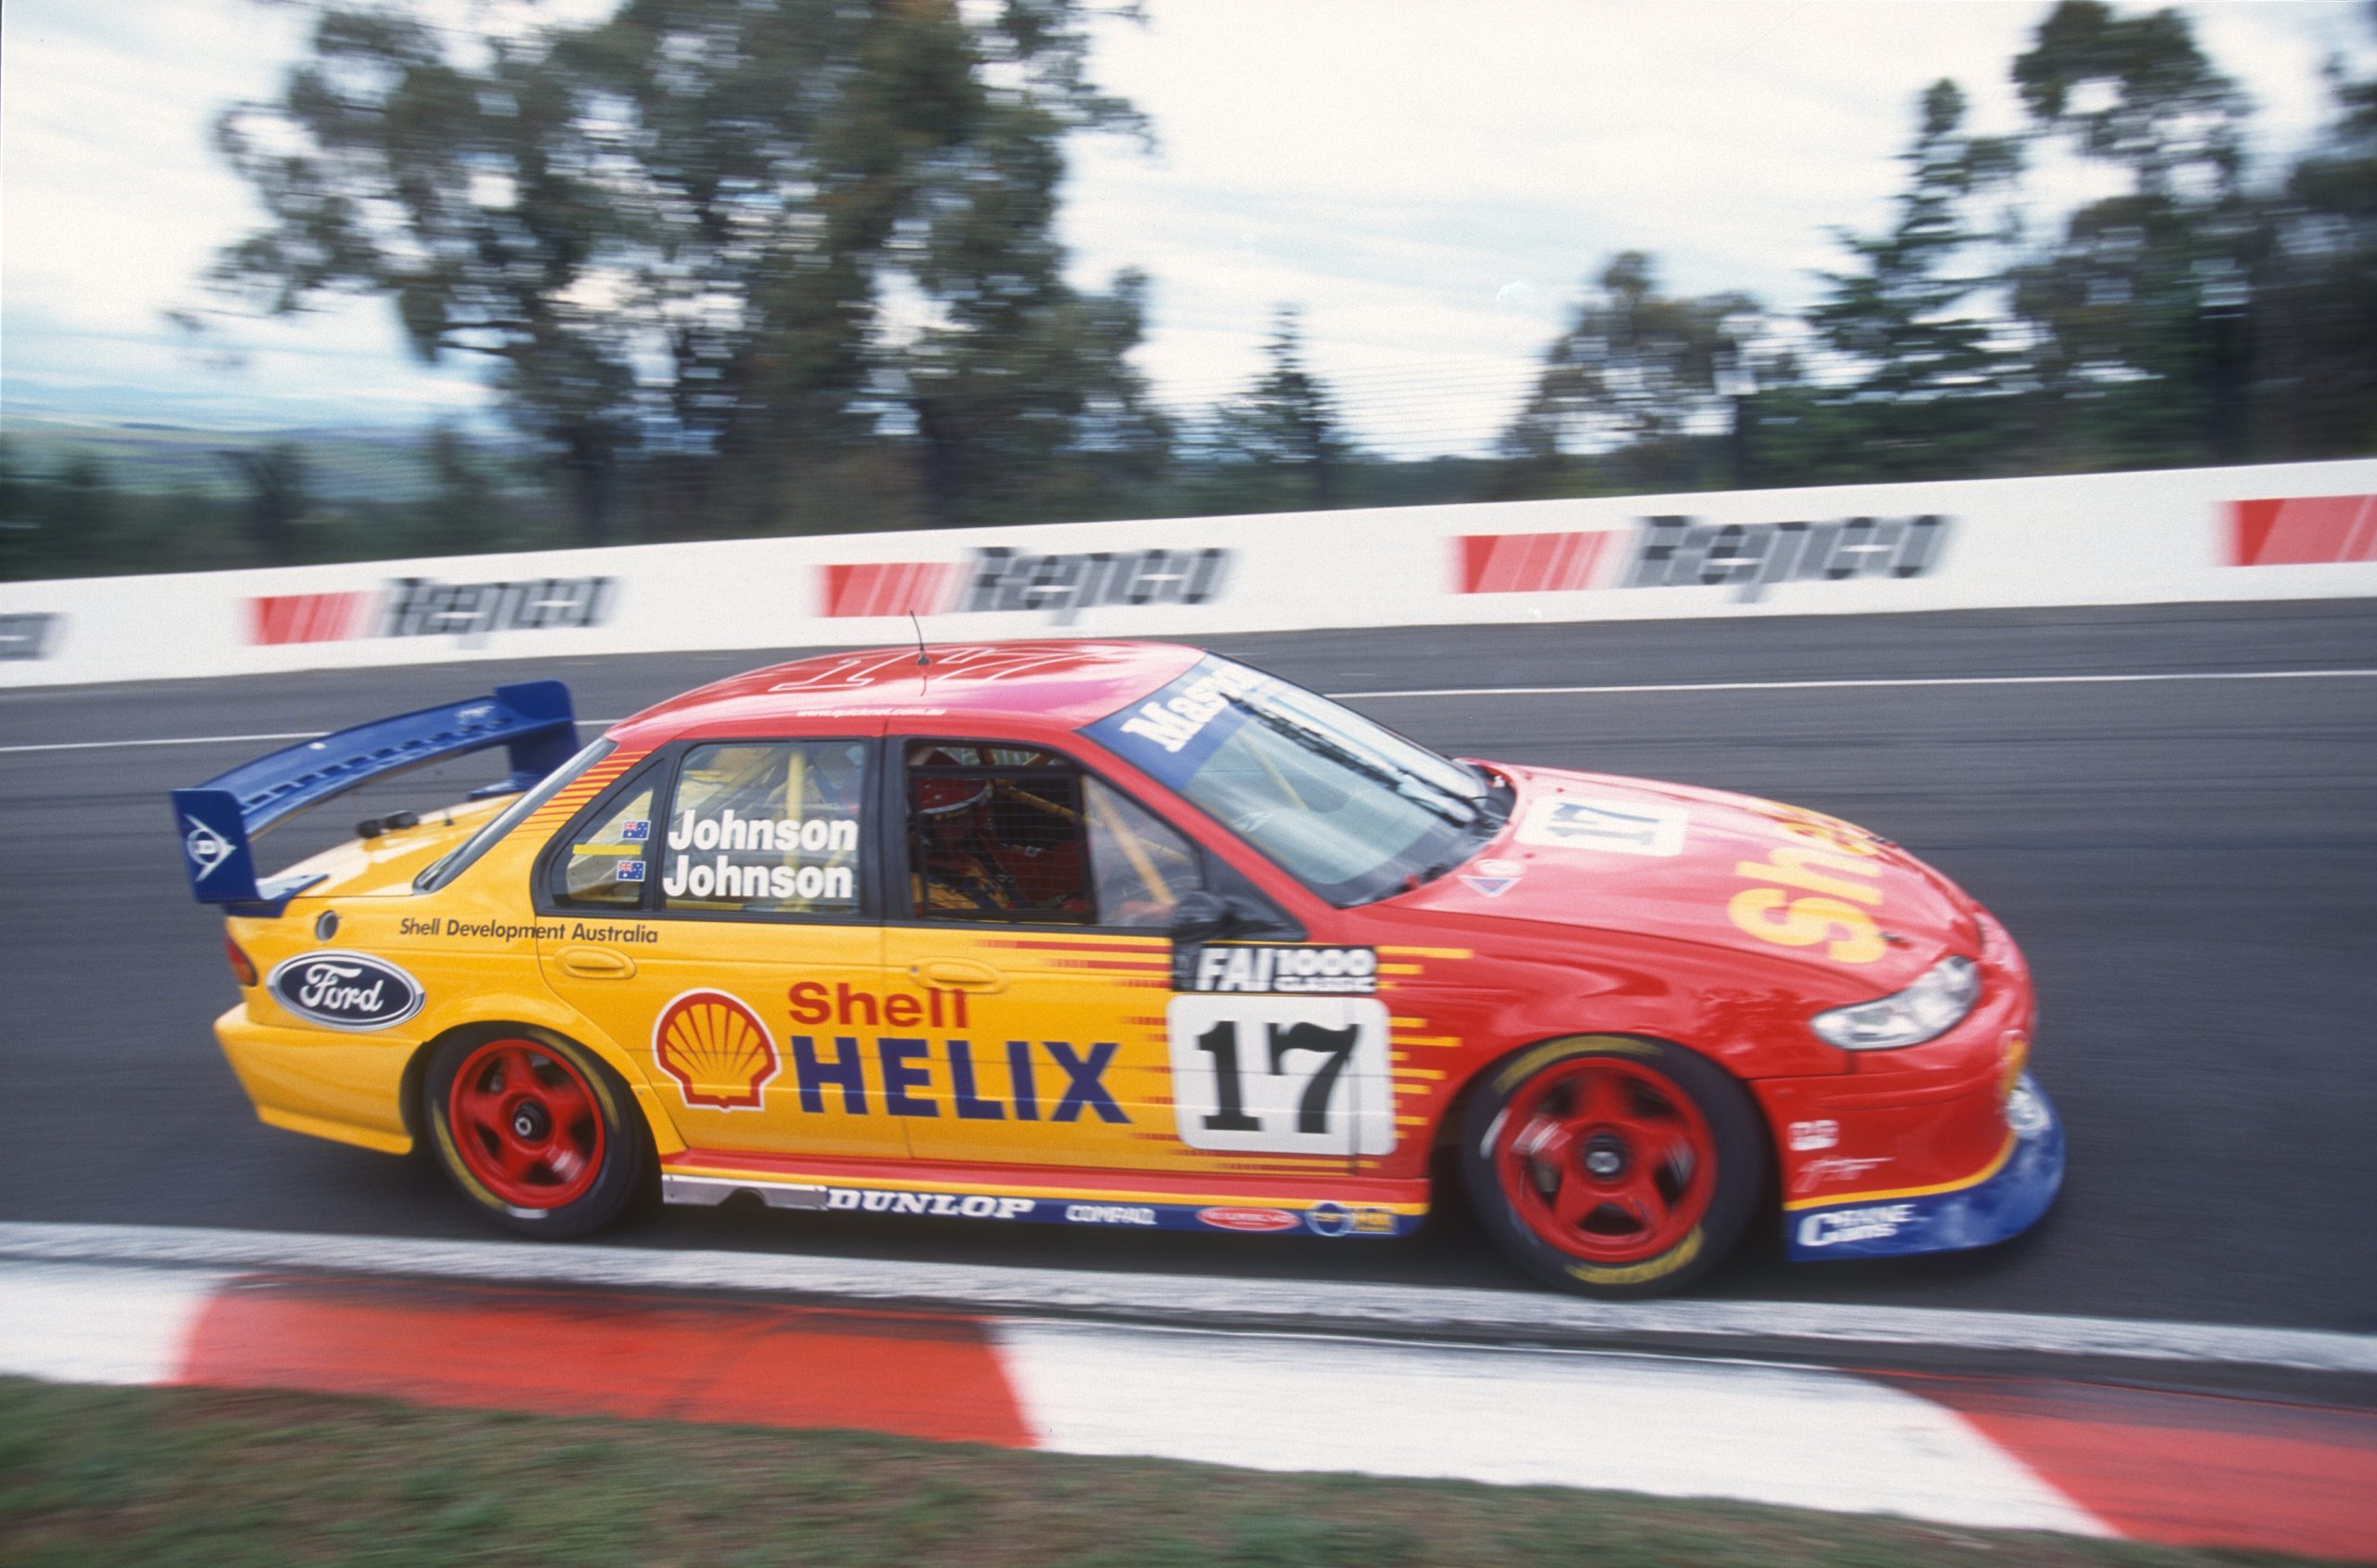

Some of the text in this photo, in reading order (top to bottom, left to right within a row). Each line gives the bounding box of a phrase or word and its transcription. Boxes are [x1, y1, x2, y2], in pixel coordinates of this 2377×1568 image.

[1618, 513, 1955, 603] Repco
[668, 809, 859, 851] Johnson
[662, 854, 853, 899] Johnson
[399, 917, 658, 943] Shell Development Australia
[299, 963, 384, 1012] Ford
[1195, 947, 1276, 992] FAI
[1275, 948, 1377, 977] 1000
[788, 980, 969, 1029] Shell
[790, 1035, 1134, 1124] HELIX
[1197, 1020, 1361, 1134] 17
[826, 1188, 1035, 1220] DUNLOP
